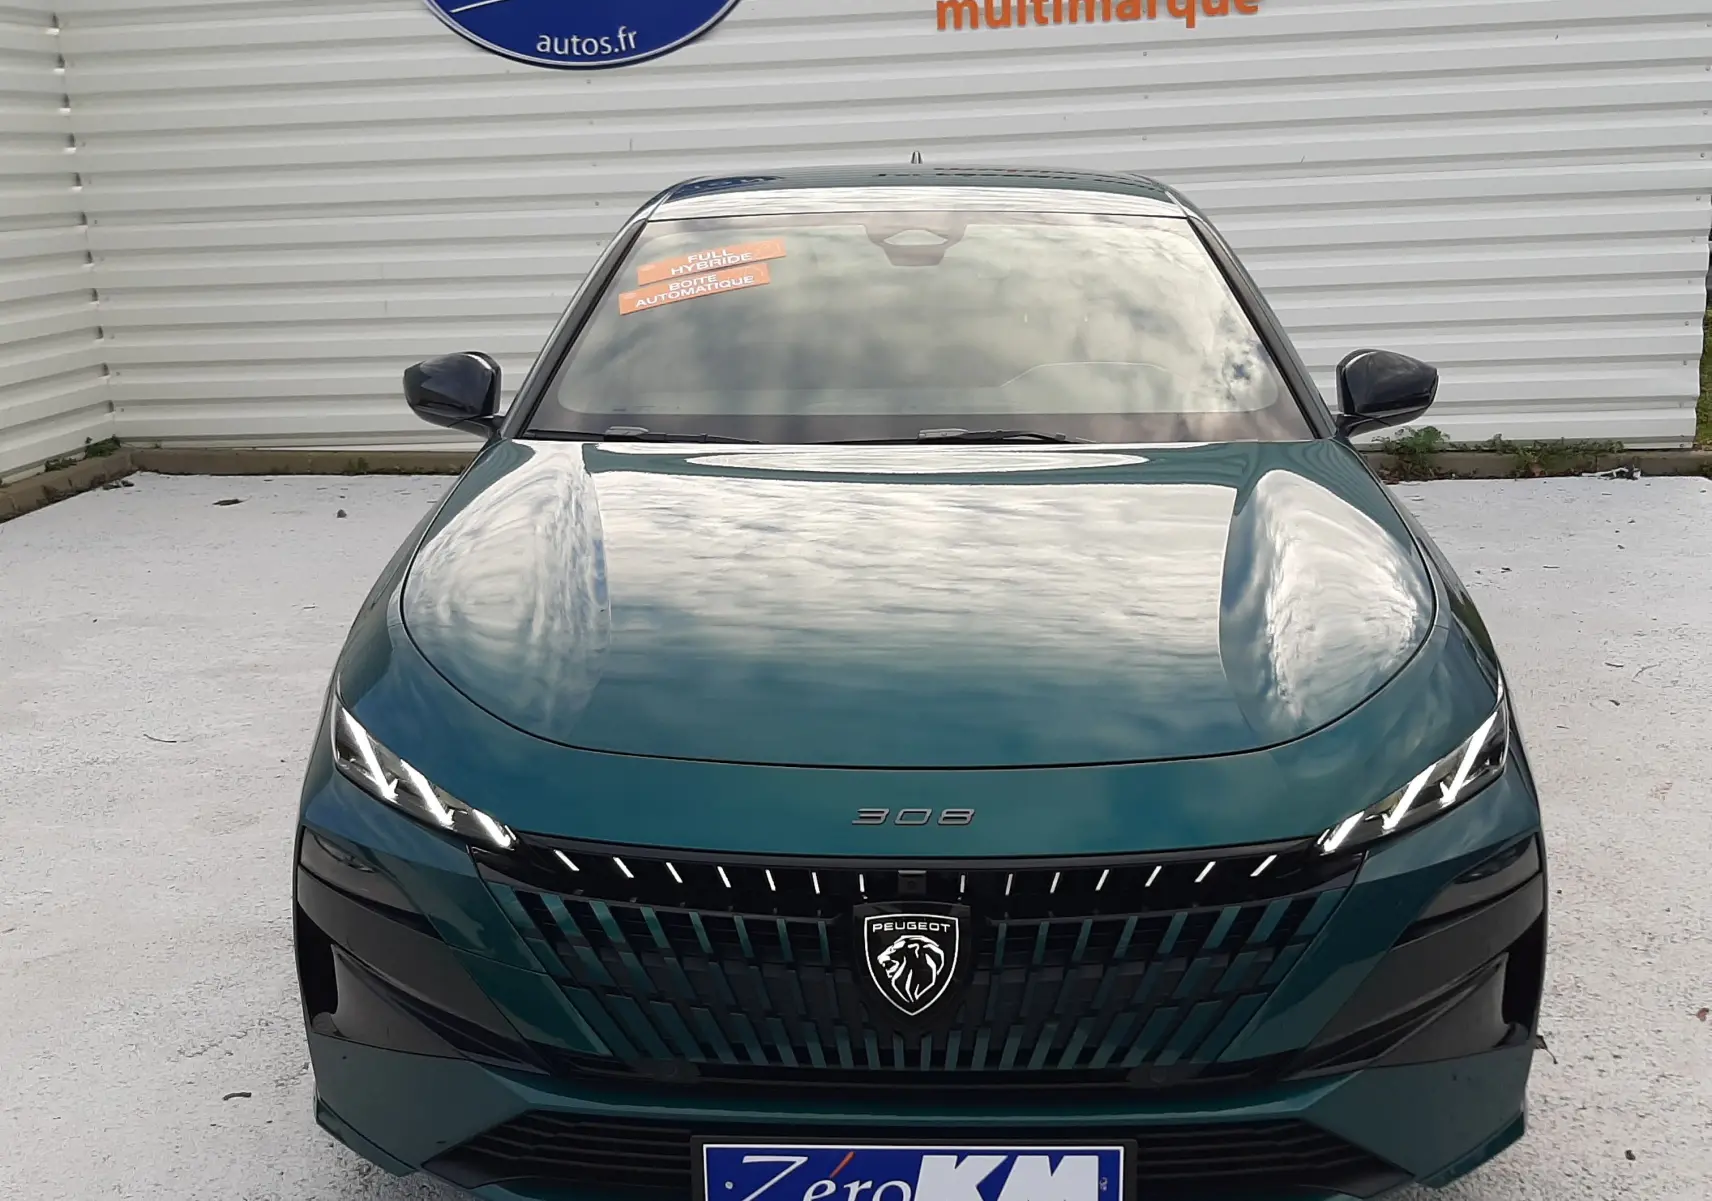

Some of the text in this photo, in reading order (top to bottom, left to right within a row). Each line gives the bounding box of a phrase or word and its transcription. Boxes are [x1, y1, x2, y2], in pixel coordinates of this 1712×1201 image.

[536, 25, 637, 56] autos.fr
[671, 252, 752, 275] HYBRIDE
[687, 249, 733, 263] FULL
[635, 275, 754, 307] AUTOMATIQUE
[669, 274, 717, 291] BOITE
[852, 808, 975, 825] 308
[872, 921, 951, 932] PEUGEOT
